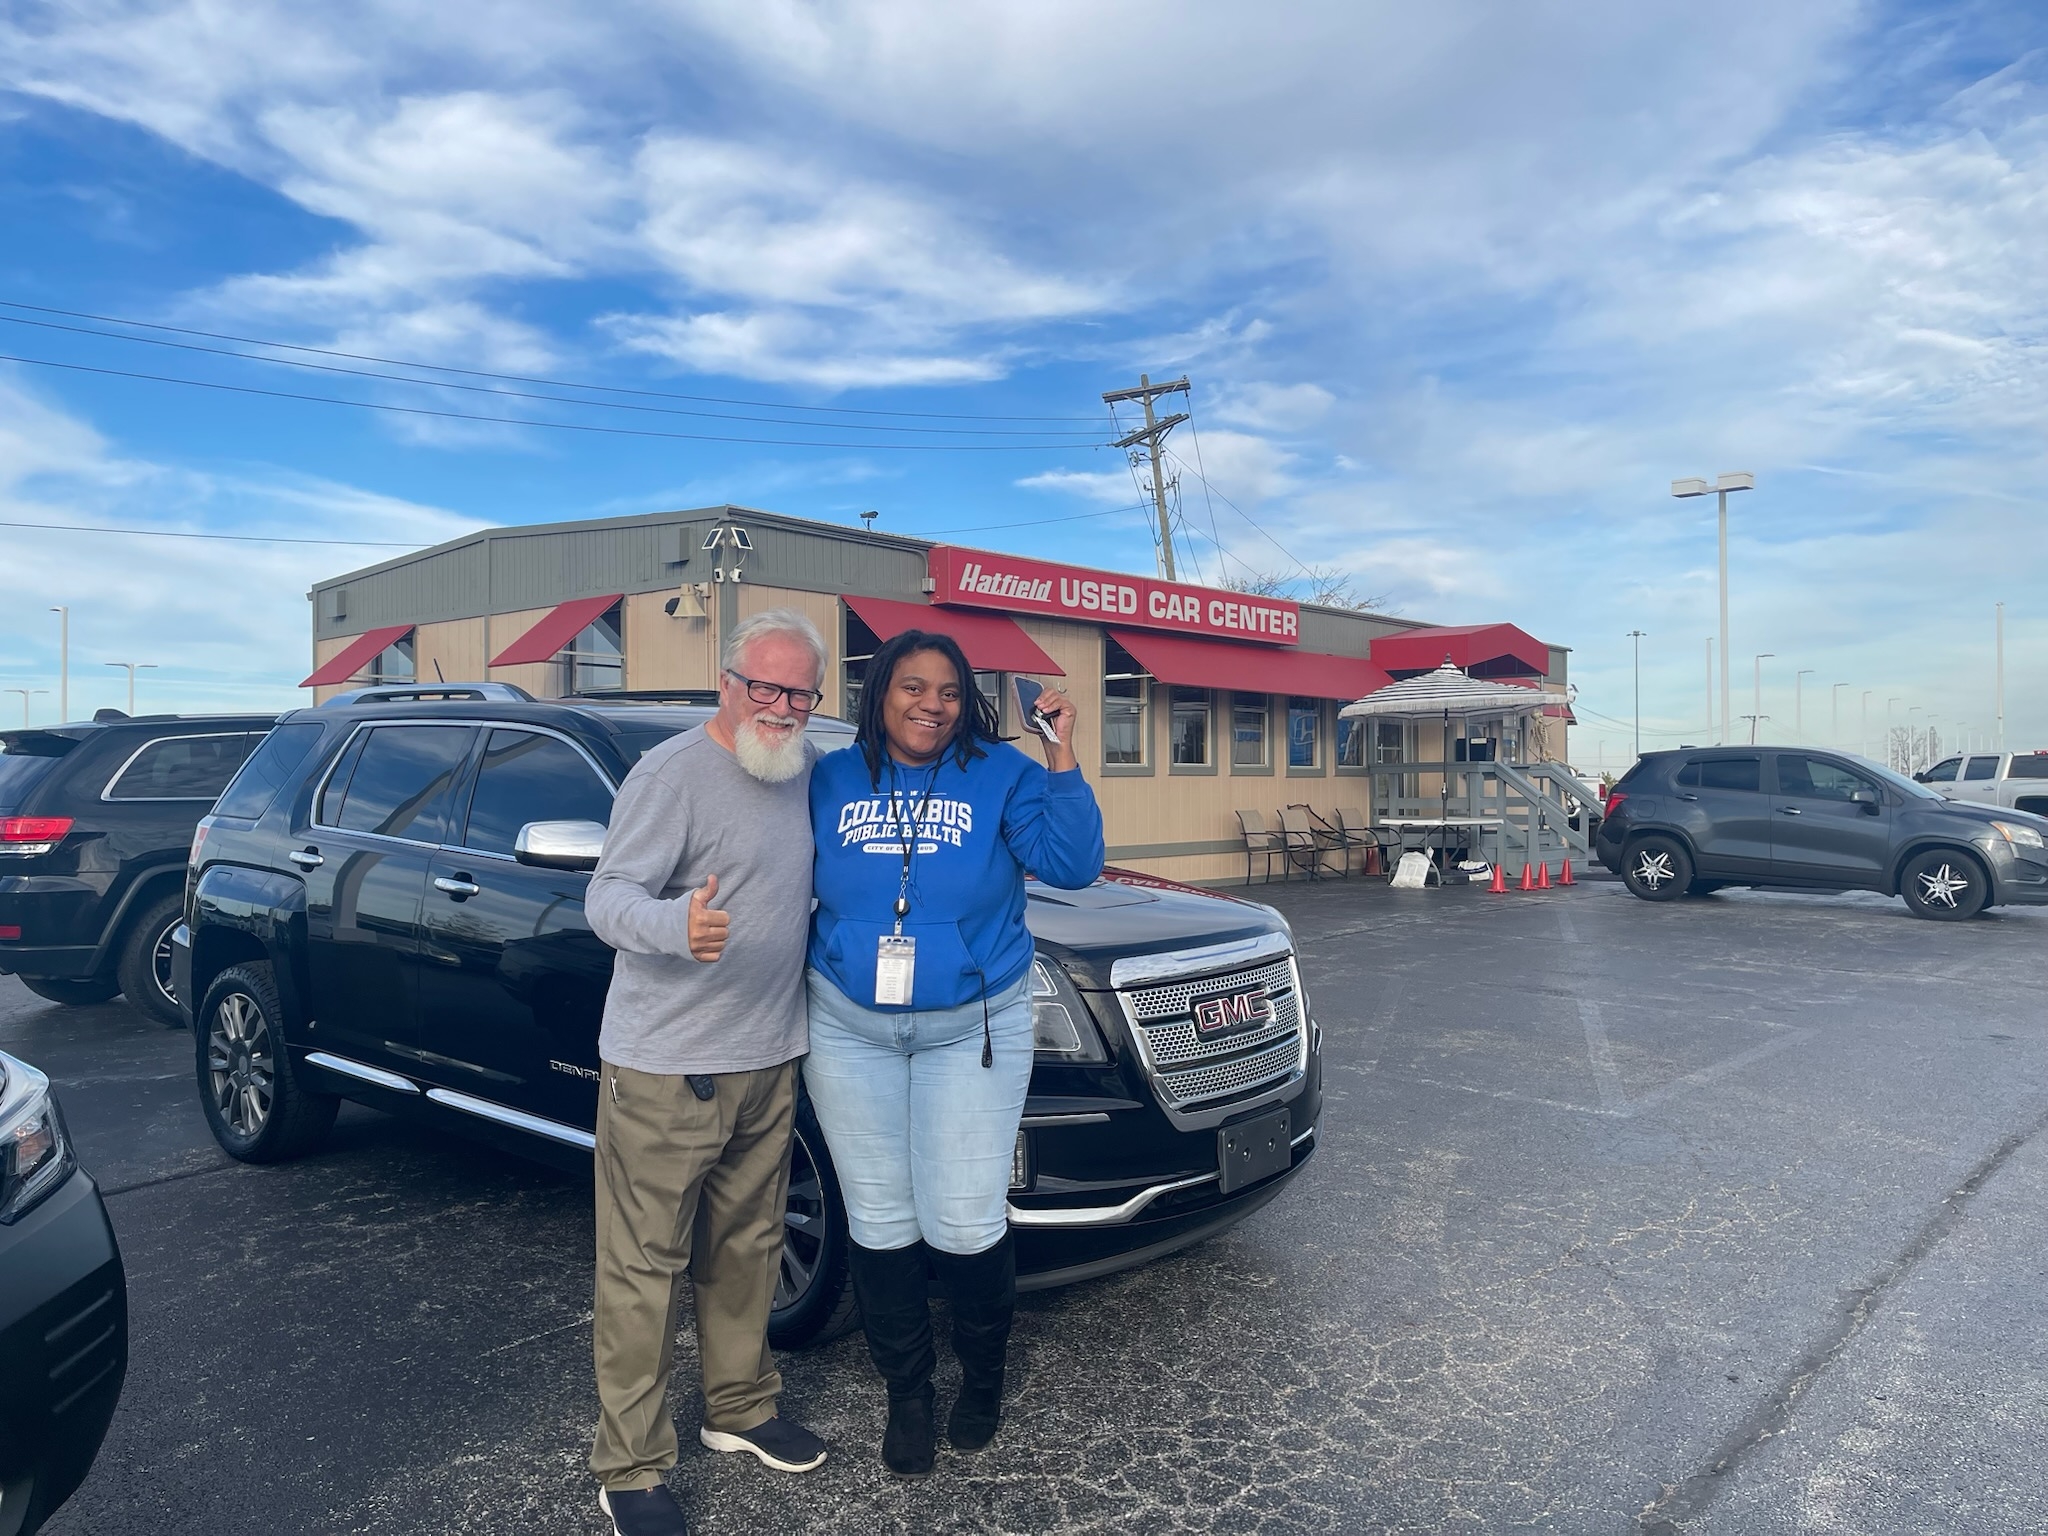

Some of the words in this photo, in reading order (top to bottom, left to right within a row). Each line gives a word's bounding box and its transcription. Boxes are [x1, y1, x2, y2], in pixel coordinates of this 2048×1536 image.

[959, 563, 1052, 602] Hatfield
[1060, 577, 1137, 615] USED
[1148, 590, 1200, 624] CAR
[1208, 600, 1297, 636] CENTER
[837, 799, 973, 834] COLUMBUS
[842, 824, 899, 847] PUBLIC
[901, 824, 962, 847] HEALTH
[1195, 989, 1270, 1032] GMC
